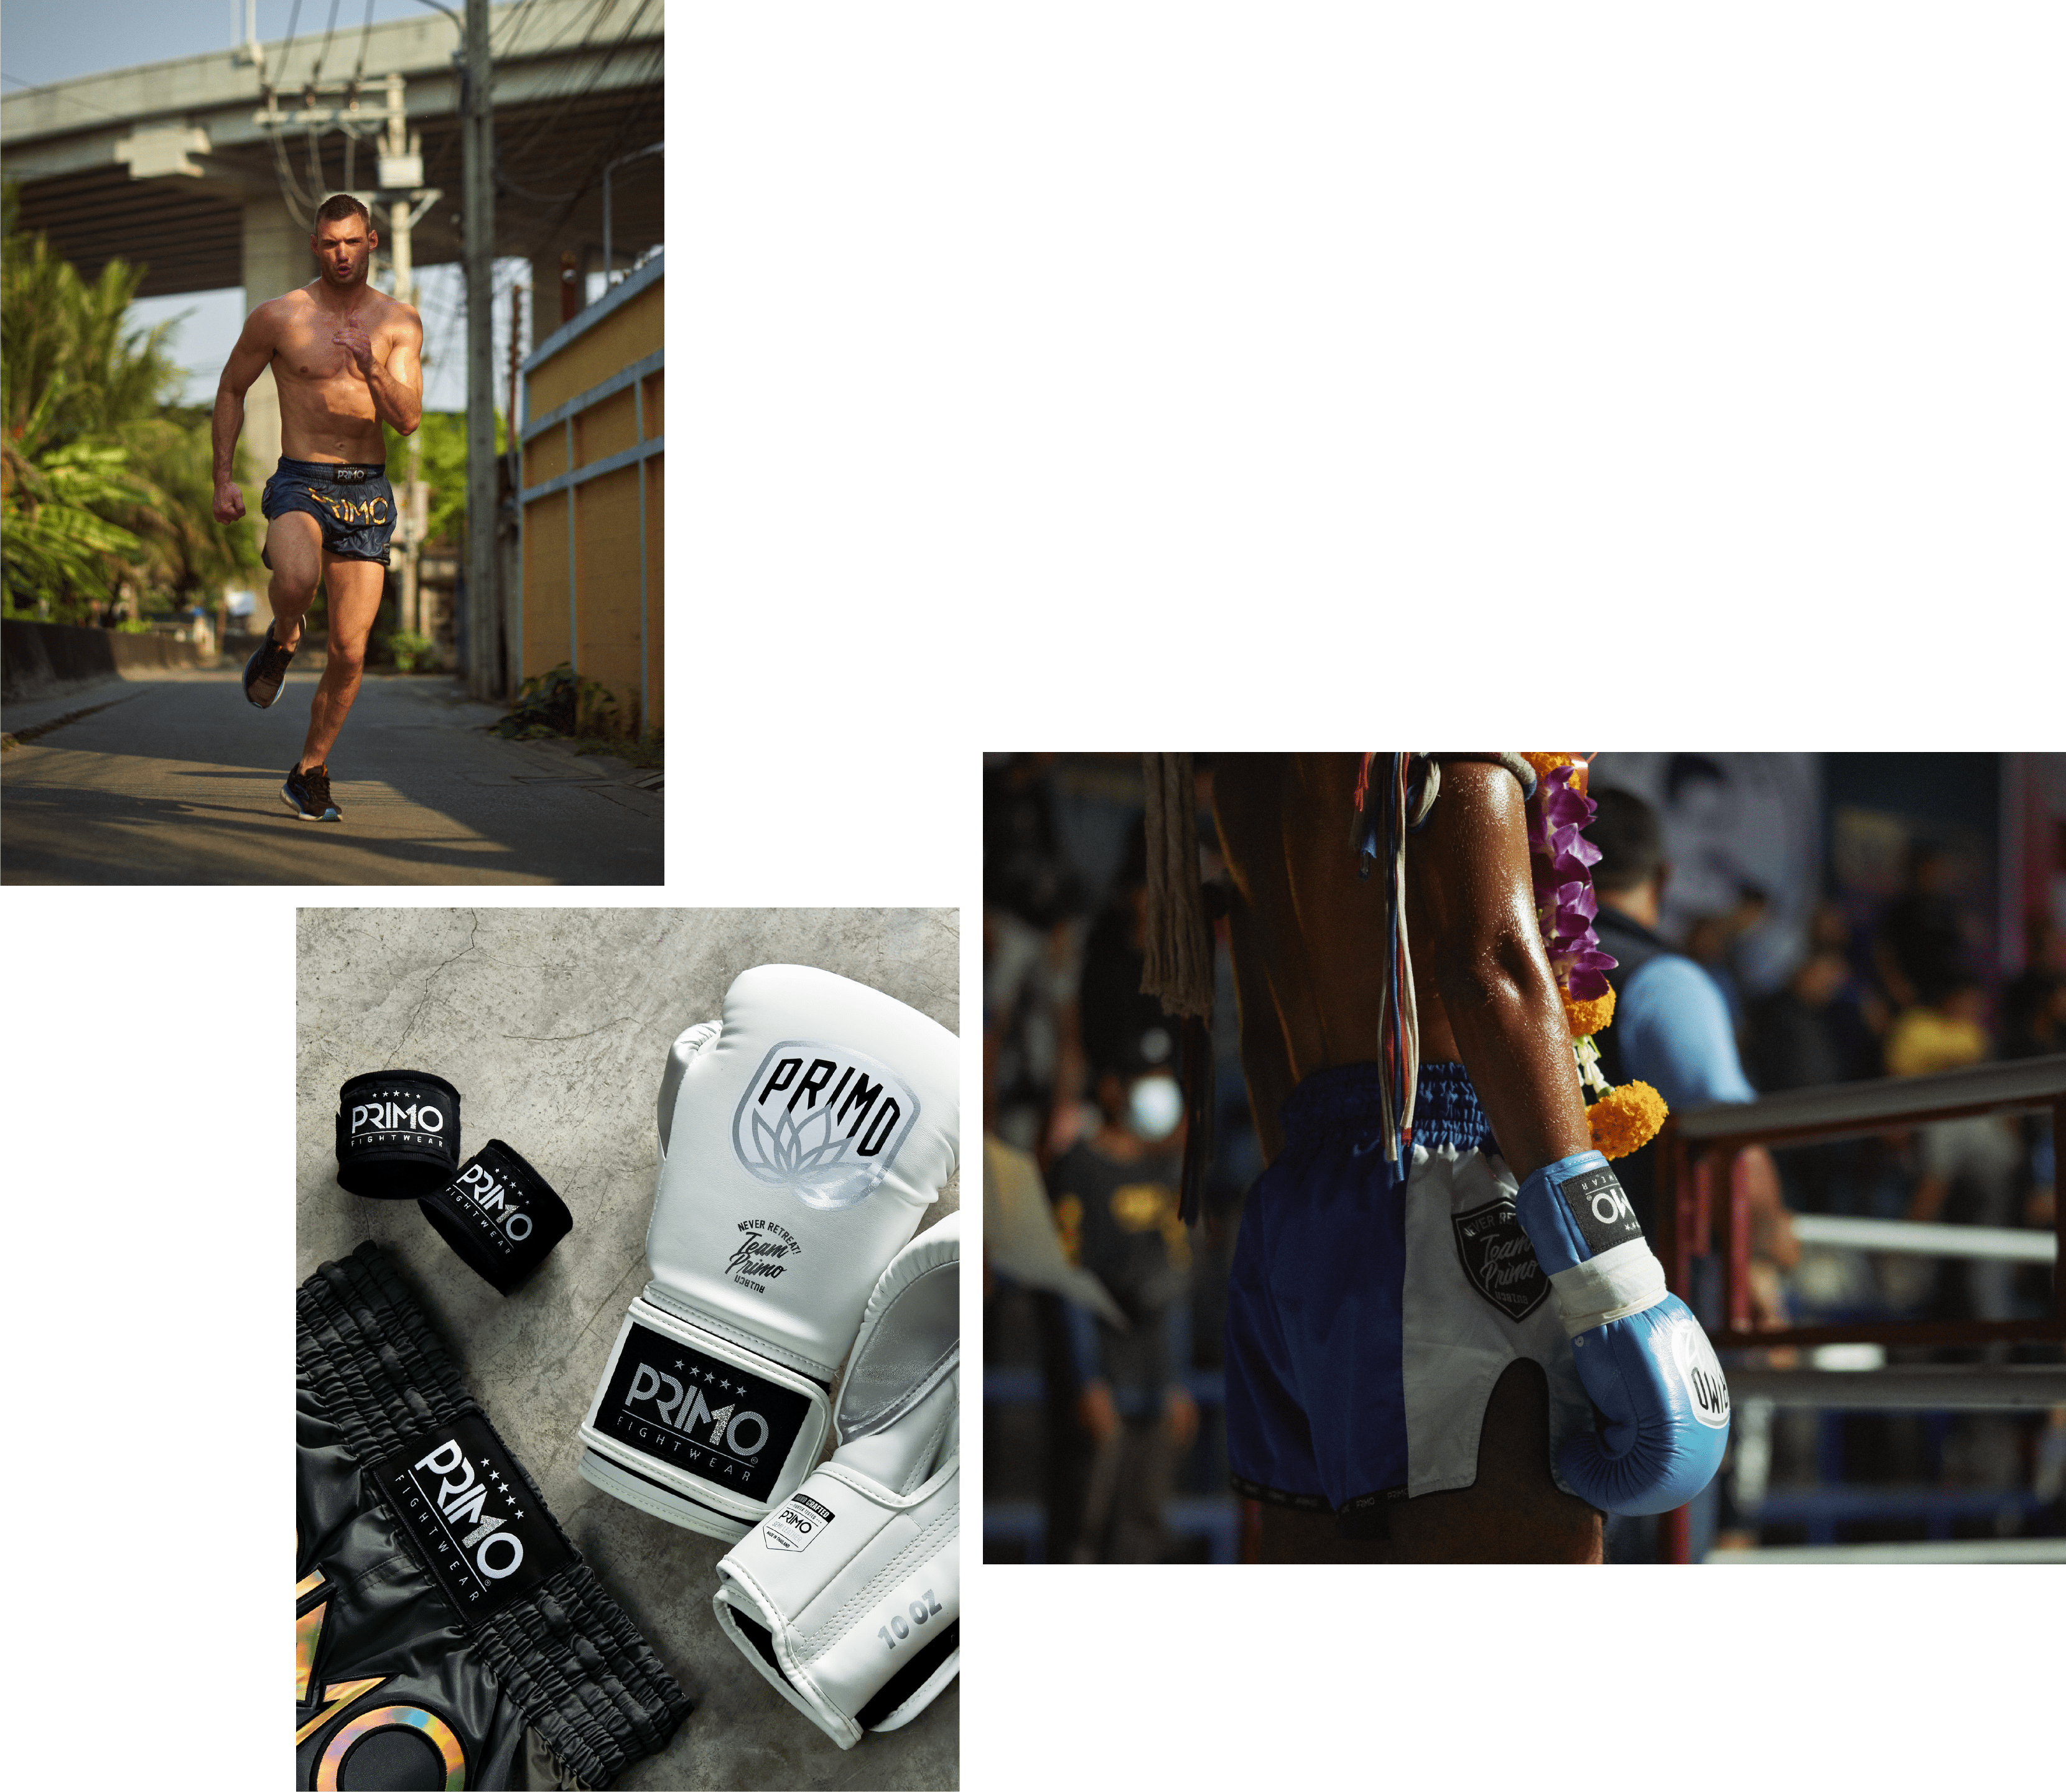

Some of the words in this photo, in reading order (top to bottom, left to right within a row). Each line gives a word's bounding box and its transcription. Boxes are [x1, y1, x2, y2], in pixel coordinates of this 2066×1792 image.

[338, 470, 365, 480] PRIMO
[351, 1102, 444, 1134] PRIMO
[758, 1057, 900, 1156] PRIMO
[351, 1134, 443, 1148] FIGHTWEAR
[456, 1164, 533, 1241] PRIMO
[445, 1187, 511, 1255] FIGHTWEAR
[737, 1219, 765, 1232] NEVER
[767, 1222, 801, 1255] RETREAT!
[1463, 1215, 1496, 1238] NEVER
[737, 1232, 789, 1258] Team
[1479, 1233, 1531, 1265] Team
[725, 1251, 788, 1279] Primo
[1479, 1259, 1538, 1291] Primo
[625, 1362, 769, 1456] PRIMO
[617, 1416, 751, 1481] FIGHTWEAR
[414, 1439, 524, 1579] PRIMO
[778, 1510, 812, 1533] PRIMO
[794, 1494, 807, 1503] HAND
[806, 1499, 830, 1518] CRAFTED
[804, 1510, 817, 1520] TESTED
[395, 1474, 479, 1601] FIGHTWEAR
[772, 1521, 784, 1530] SEMI
[783, 1525, 803, 1543] LEATHER
[776, 1536, 790, 1548] THAILAND
[877, 1615, 910, 1650] 10
[909, 1589, 942, 1625] OZ
